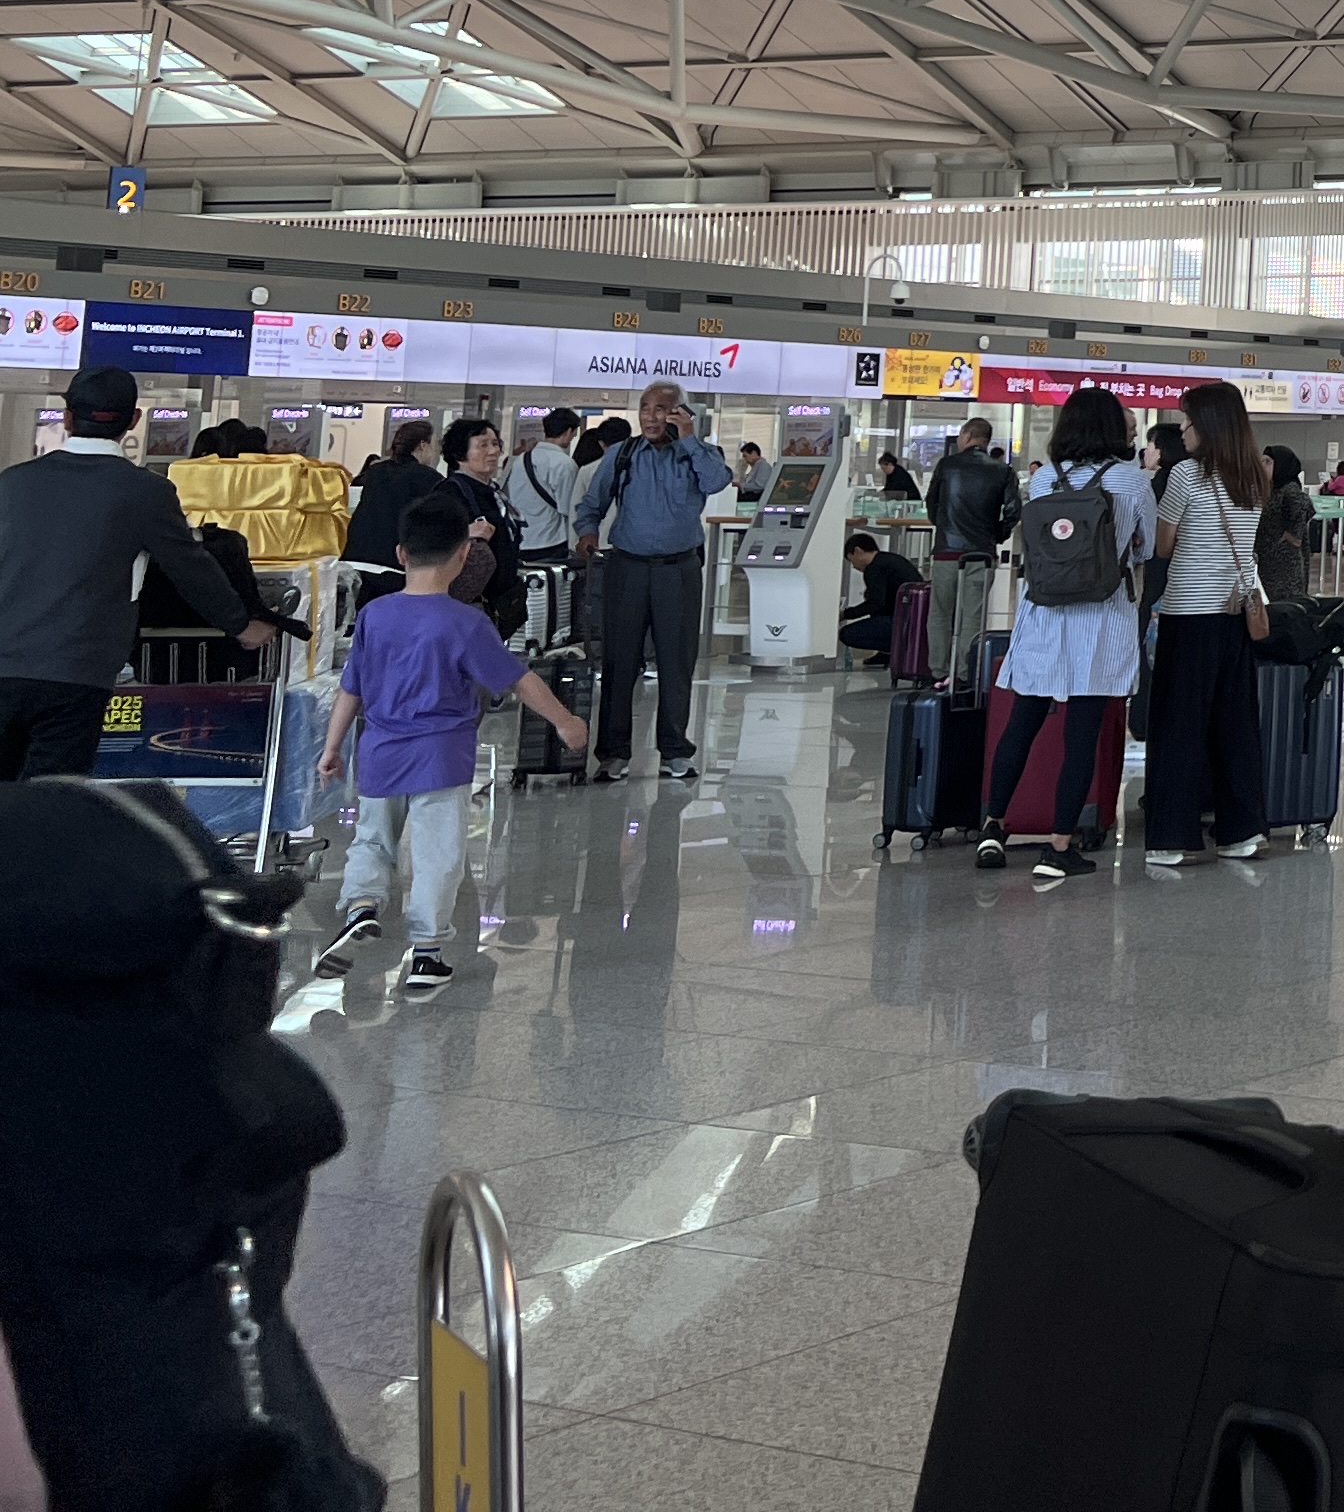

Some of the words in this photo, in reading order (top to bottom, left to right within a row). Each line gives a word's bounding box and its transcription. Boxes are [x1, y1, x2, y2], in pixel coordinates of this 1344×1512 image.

[117, 180, 137, 208] 2
[0, 270, 40, 292] B20
[130, 279, 167, 300] B21
[338, 293, 371, 312] B22
[443, 300, 475, 318] B23
[613, 312, 640, 329] B24
[698, 317, 724, 334] B25
[838, 327, 862, 342] B26
[588, 355, 648, 375] ASIANA
[653, 358, 722, 378] AIRLINES
[1038, 380, 1075, 395] Economy
[106, 695, 143, 710] 025
